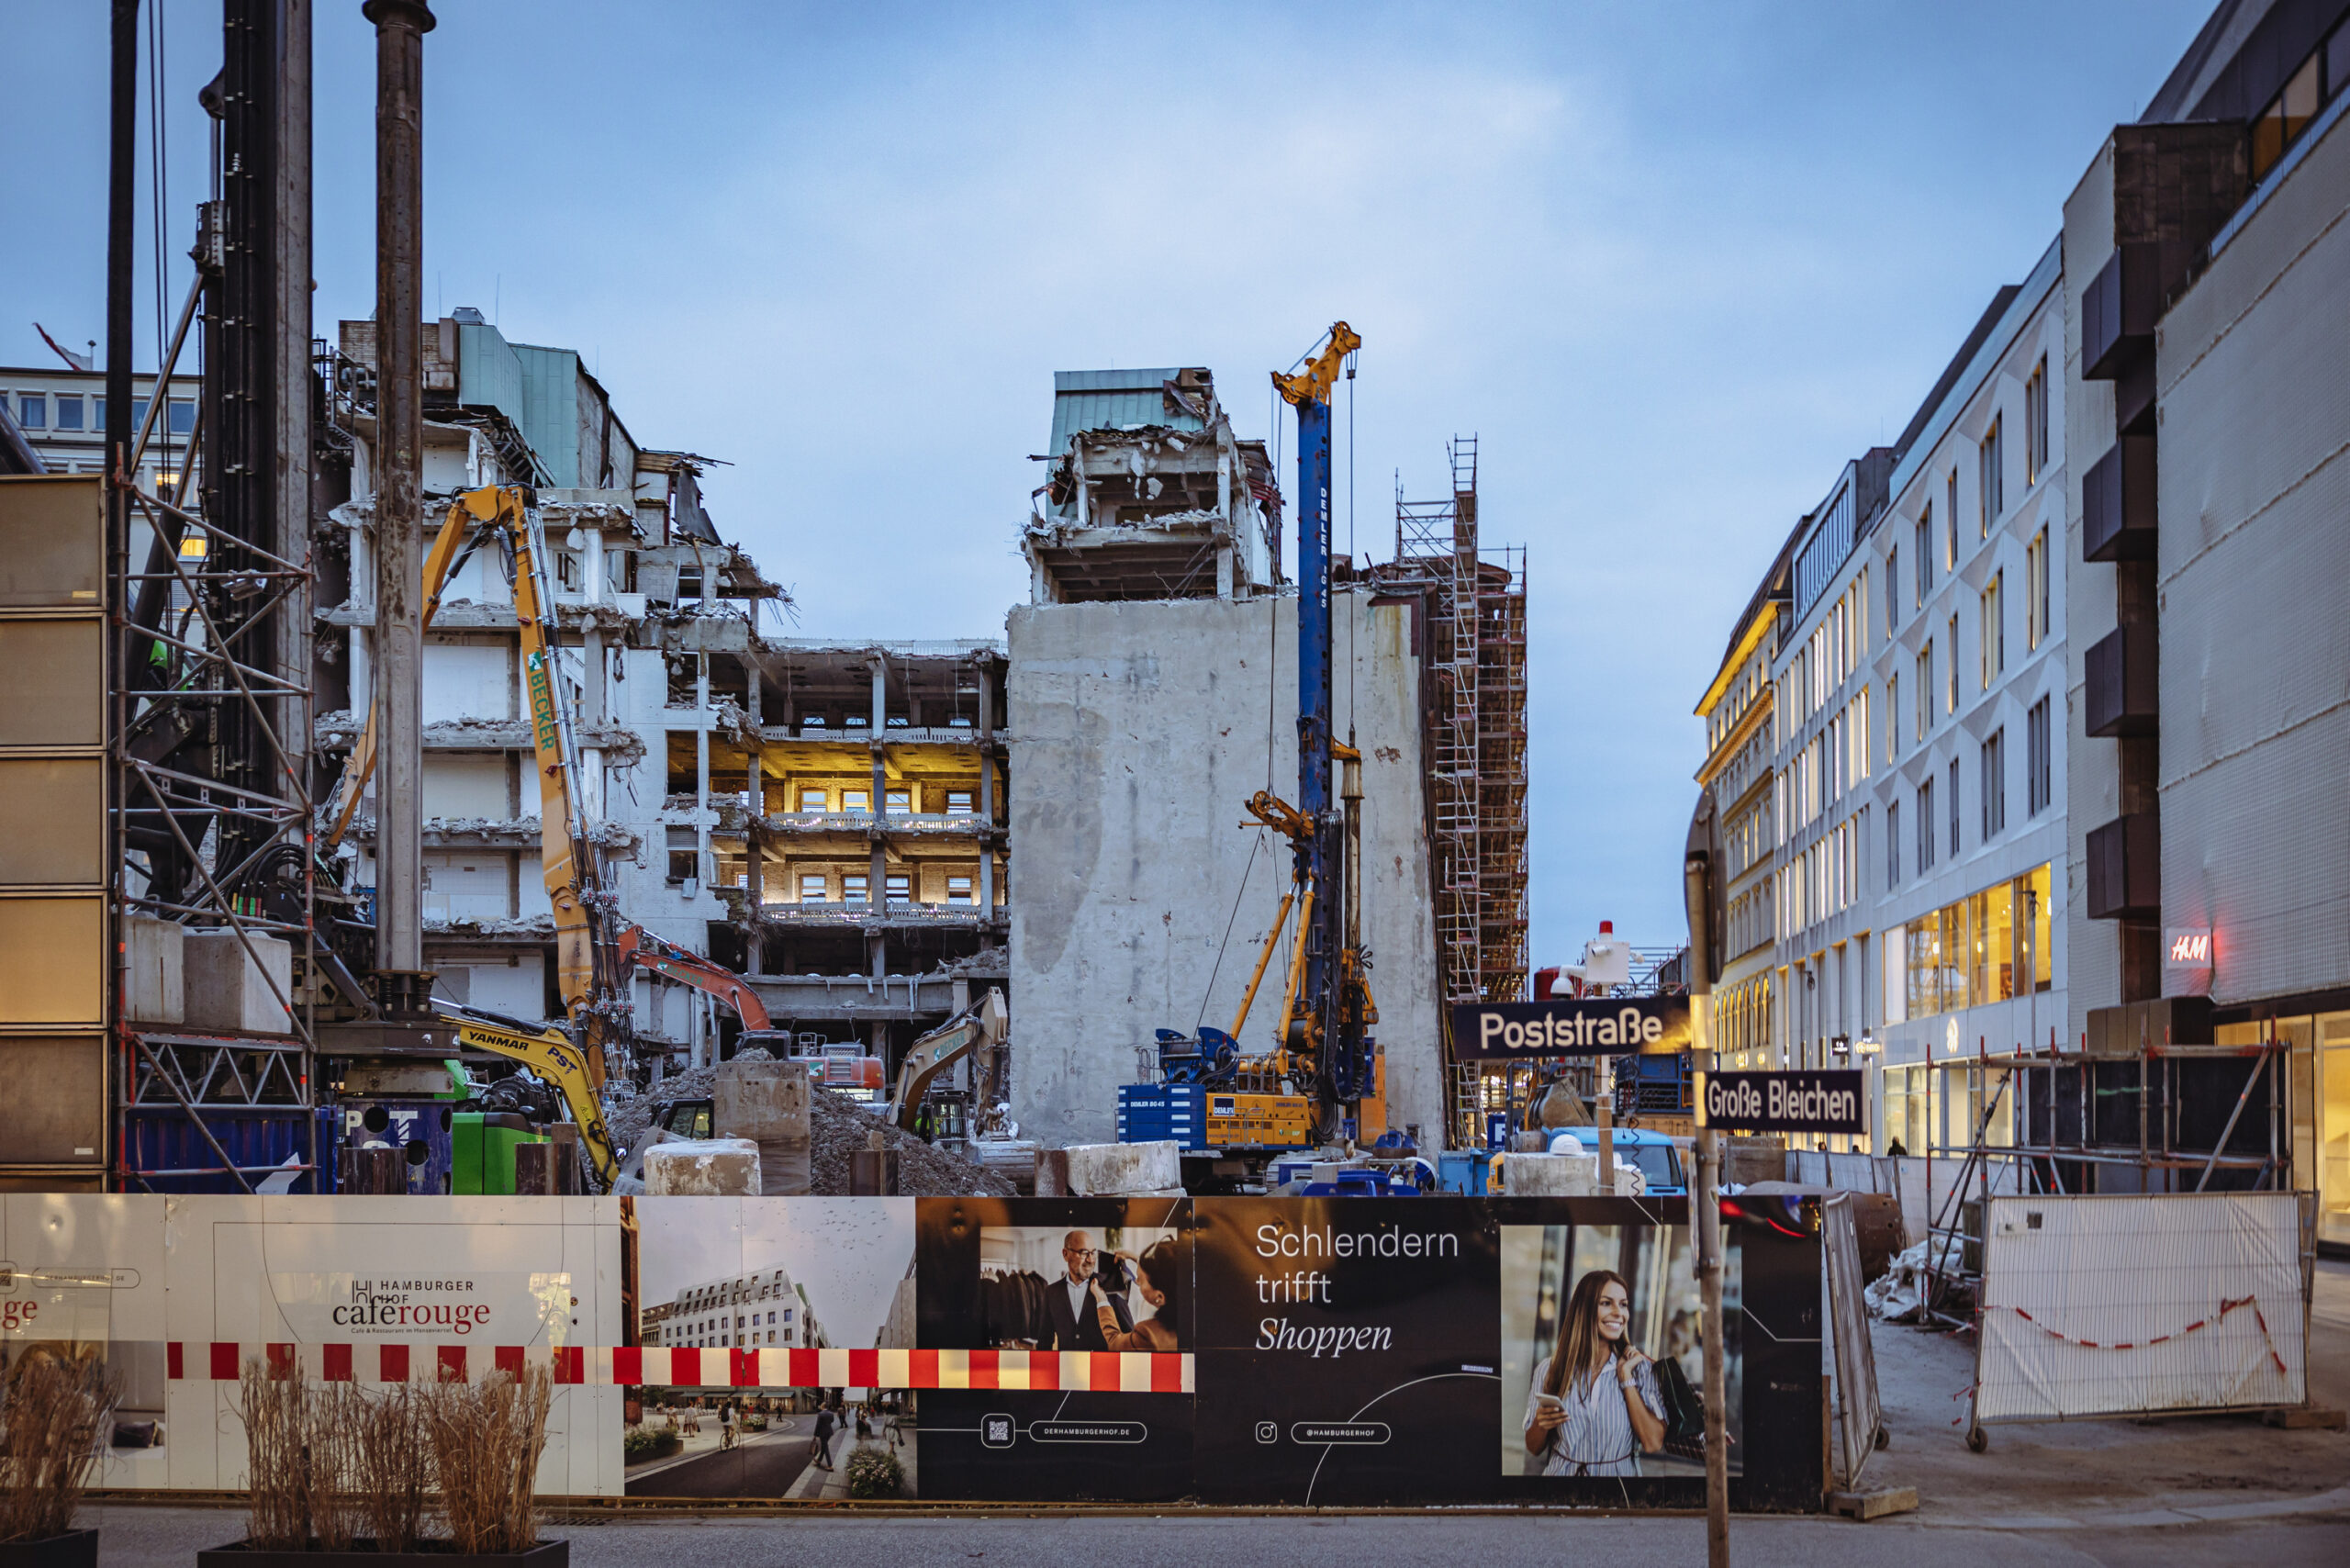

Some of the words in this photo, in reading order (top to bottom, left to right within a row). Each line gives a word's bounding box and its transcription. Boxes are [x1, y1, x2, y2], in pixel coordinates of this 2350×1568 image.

[530, 671, 555, 752] BECKER
[2170, 934, 2210, 962] H&M
[666, 965, 704, 987] BECKER
[469, 1031, 530, 1051] YANMAR
[1480, 1007, 1662, 1050] Poststraße
[939, 1030, 965, 1058] BECKER
[547, 1046, 578, 1075] PST
[1708, 1080, 1762, 1118] Große
[1768, 1080, 1855, 1121] Bleichen
[1256, 1224, 1459, 1258] Schlendern
[380, 1280, 475, 1292] HAMBURGER
[380, 1294, 409, 1305] HOF
[1256, 1271, 1332, 1304] trifft
[0, 1300, 38, 1330] ge
[1255, 1317, 1393, 1359] Shoppen
[1044, 1428, 1130, 1436] DERHAMBURGERHOF.DE
[1306, 1428, 1376, 1437] @HAMBURGERHOF
